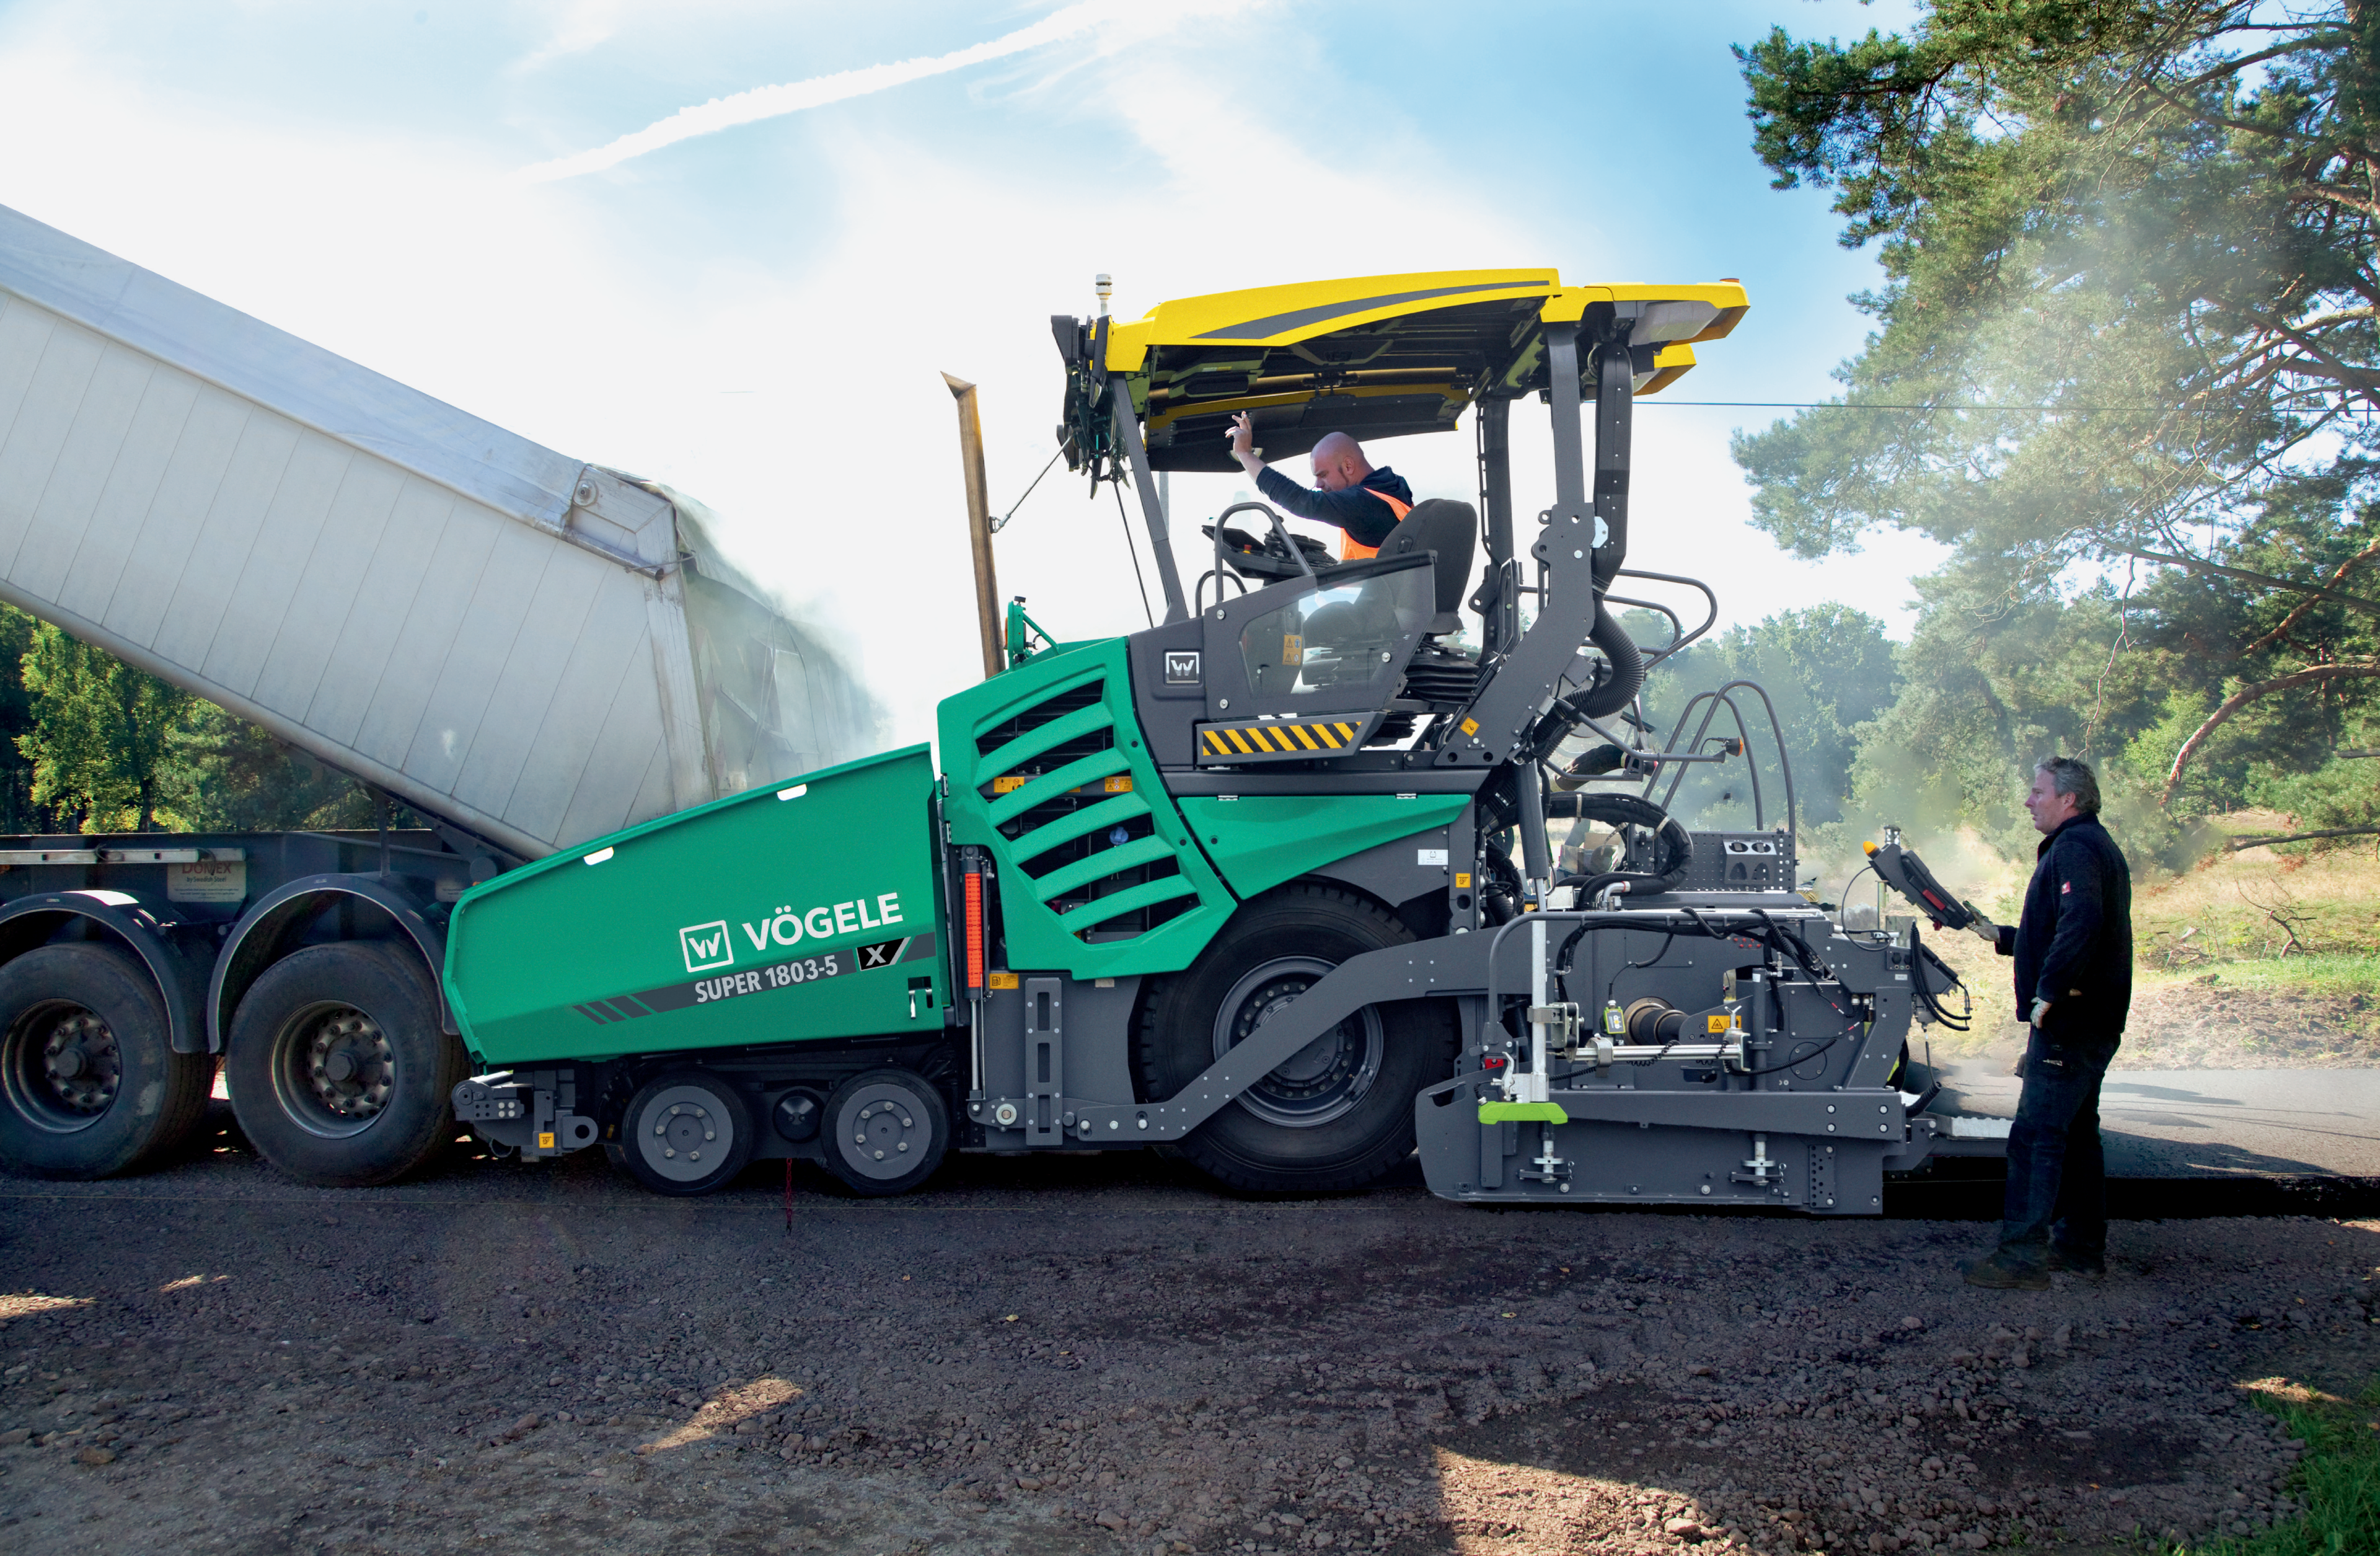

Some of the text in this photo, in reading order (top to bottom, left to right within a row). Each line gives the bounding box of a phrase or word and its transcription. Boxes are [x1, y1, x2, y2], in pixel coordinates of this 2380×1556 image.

[741, 892, 904, 951] VÖGELE
[695, 944, 886, 1003] SUPER 1803-5 X
